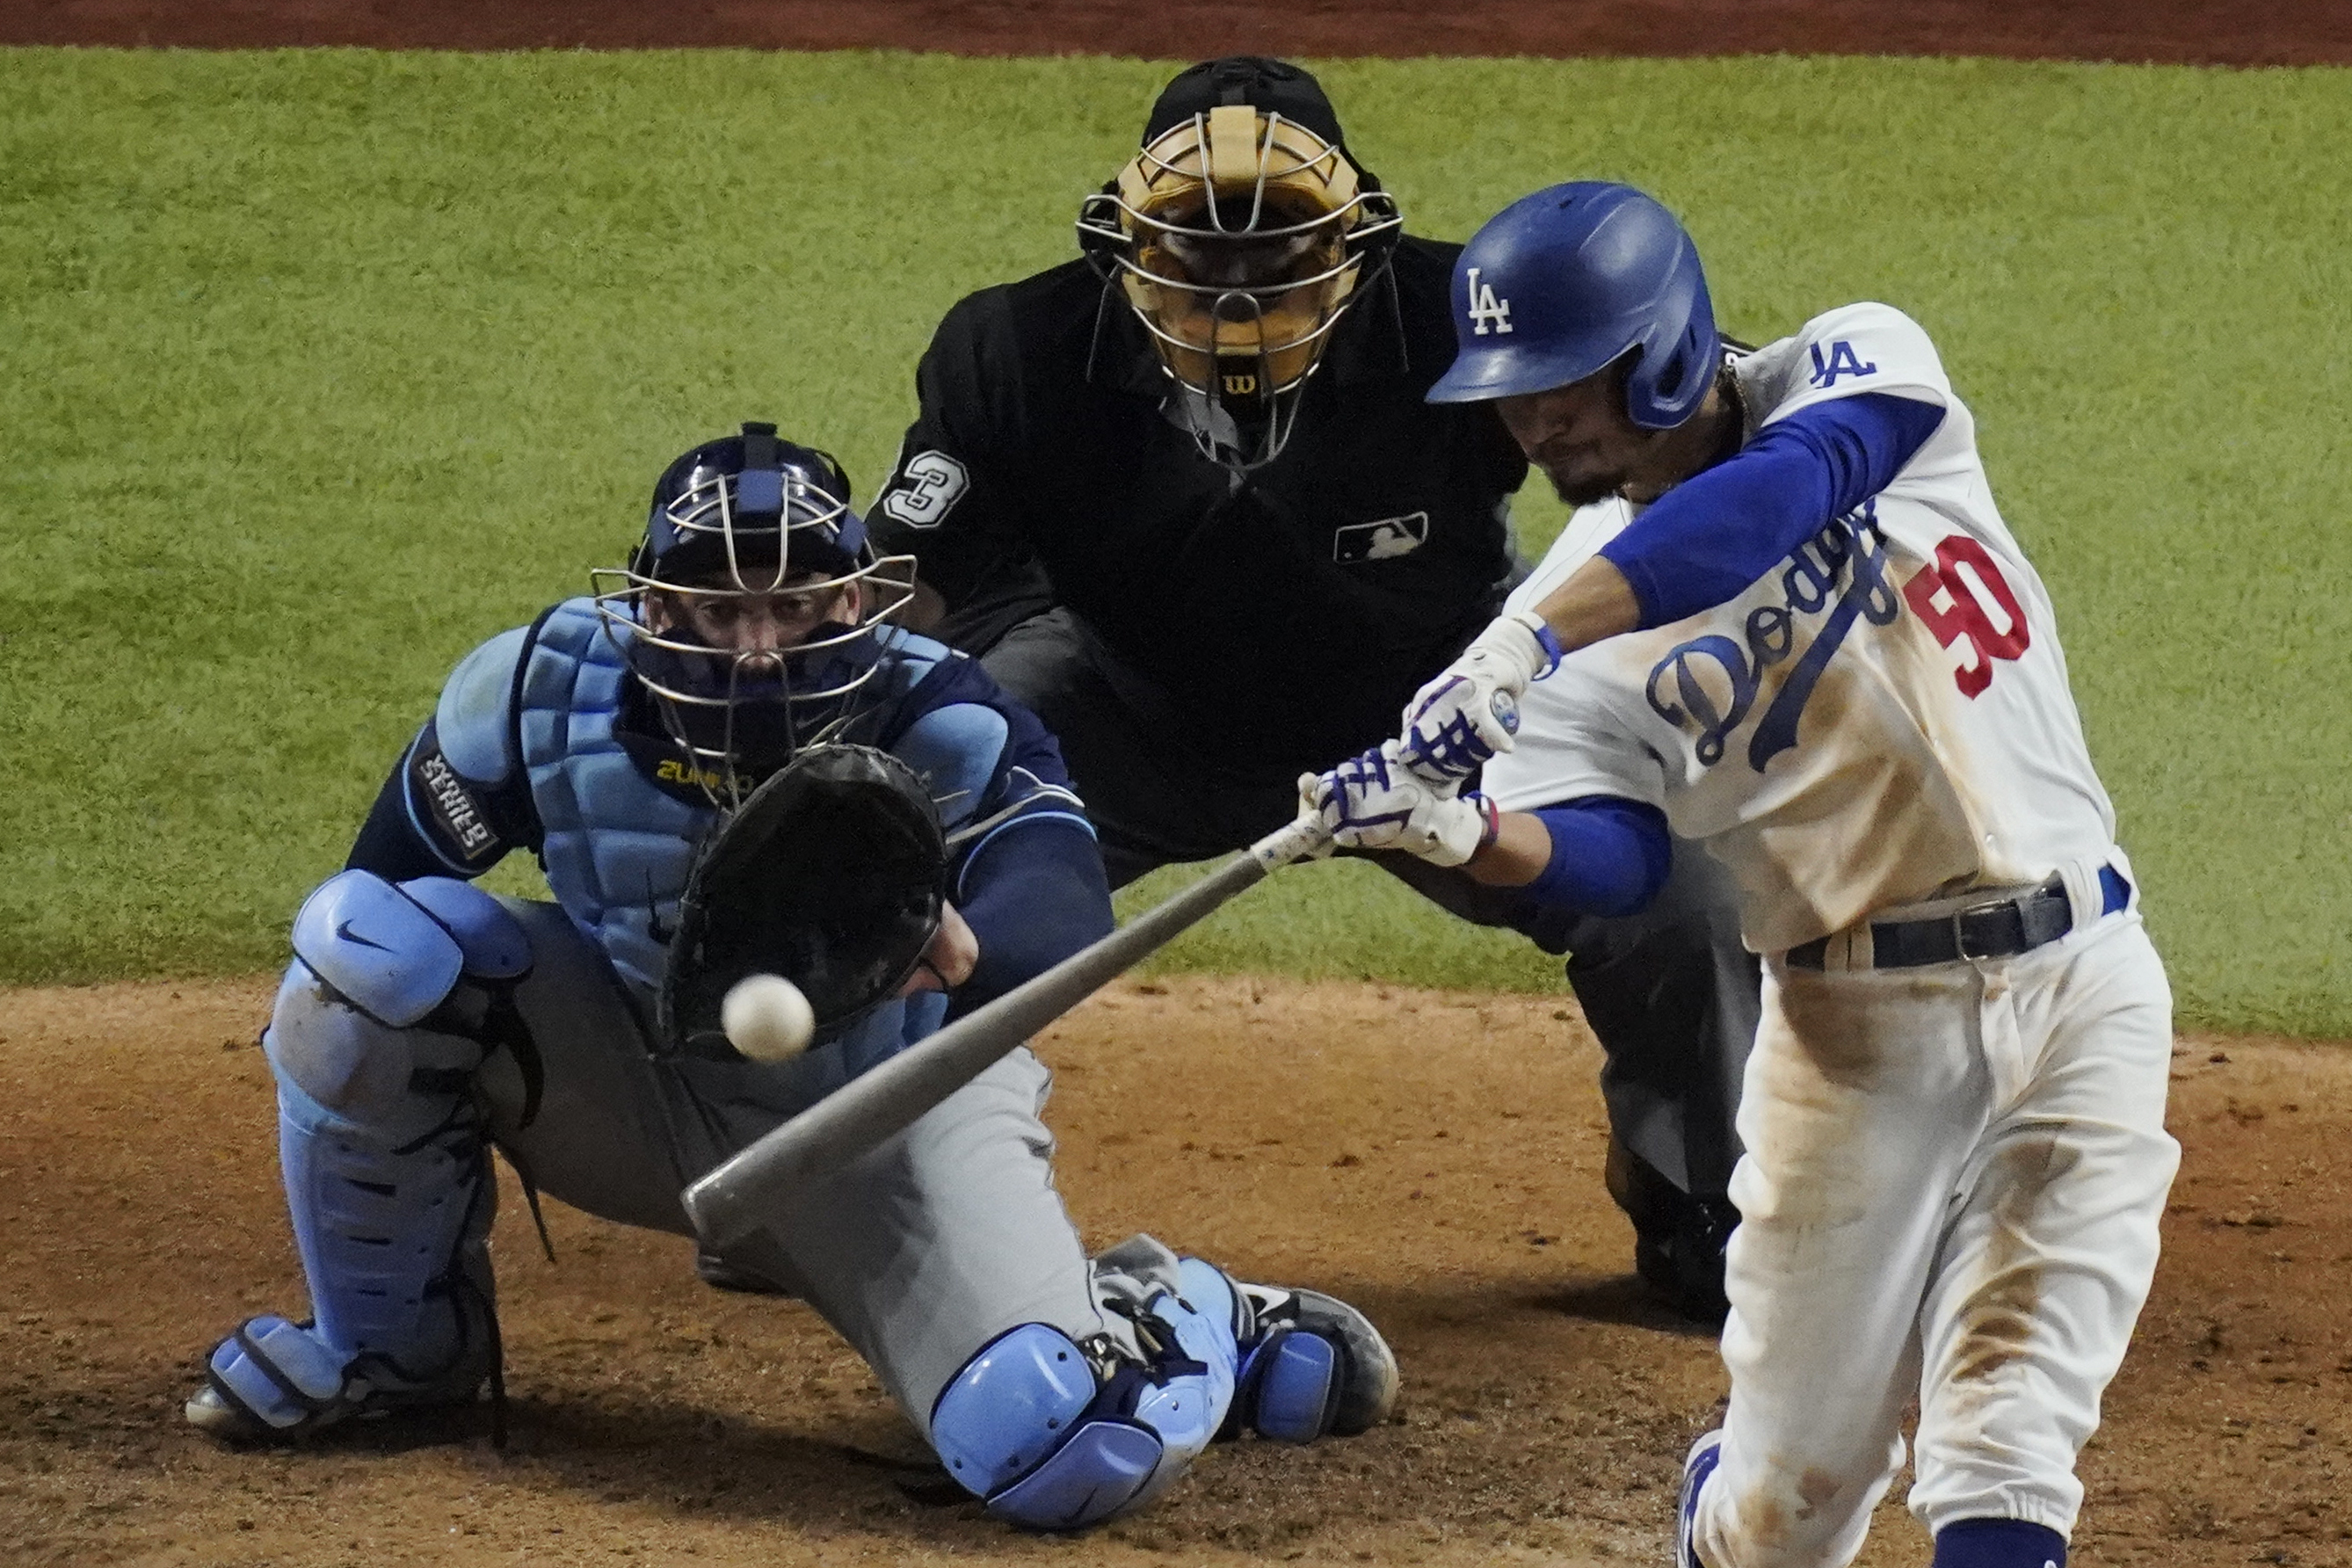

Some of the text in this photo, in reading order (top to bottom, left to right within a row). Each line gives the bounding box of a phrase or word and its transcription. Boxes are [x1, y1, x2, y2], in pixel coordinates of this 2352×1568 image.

[1467, 268, 1513, 335] LA
[883, 449, 970, 528] 3
[1646, 497, 1898, 773] Dodg
[1903, 534, 2030, 701] 50
[420, 759, 475, 848] SERIES
[432, 754, 488, 842] WORLD
